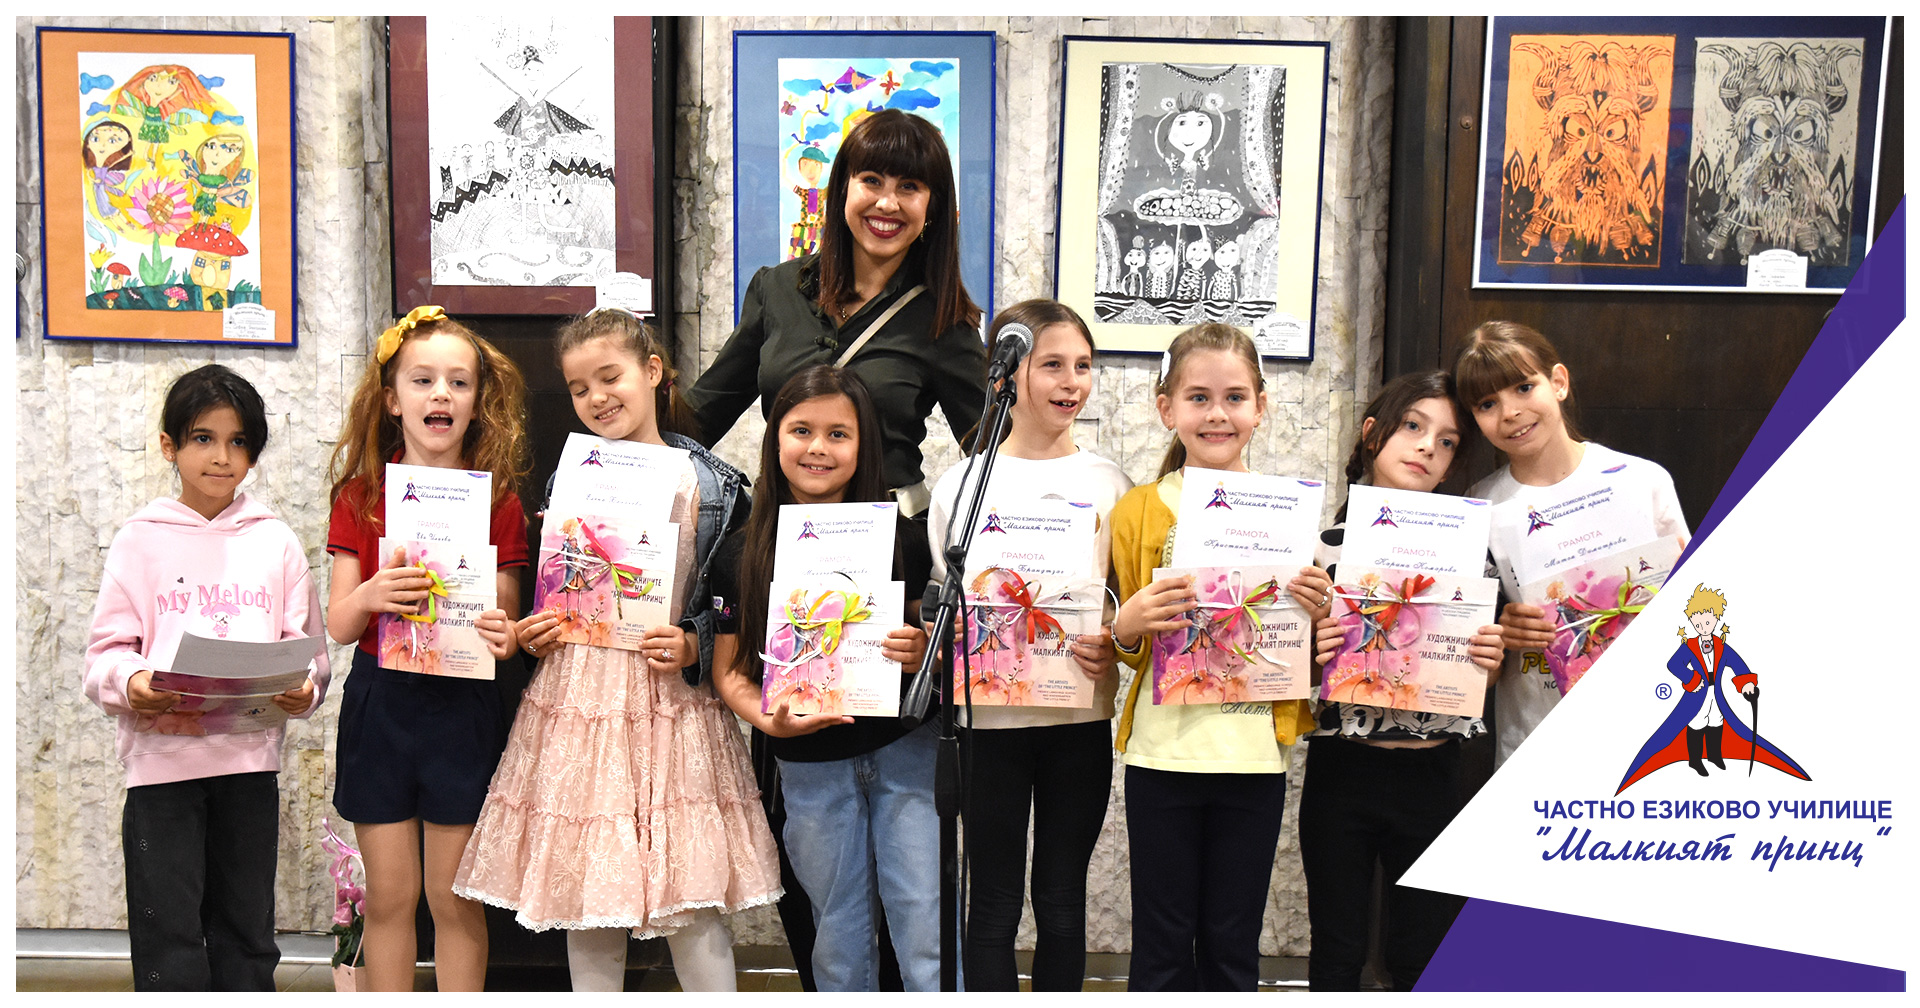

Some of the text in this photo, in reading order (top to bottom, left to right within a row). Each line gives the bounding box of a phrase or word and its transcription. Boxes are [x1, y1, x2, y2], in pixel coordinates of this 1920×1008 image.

[1541, 504, 1562, 514] ЧАСТНО
[1562, 495, 1586, 507] ЕЗИКОВО
[417, 520, 450, 529] ГРАМОТА
[1225, 528, 1269, 539] ГРАМОТА
[1203, 539, 1249, 550] Кристина
[1557, 530, 1603, 550] ГРАМОТА
[1001, 551, 1045, 561] ГРАМОТА
[1392, 546, 1437, 558] ГРАМОТА
[817, 555, 852, 563] РАМОТА
[1374, 557, 1457, 573] Карина Комарова
[157, 583, 273, 615] My Melody
[442, 601, 484, 612] ХУДОЖНИЦИТЕ
[1248, 622, 1298, 634] ХДОЖНИЦИТЕ
[1268, 632, 1277, 640] НА
[1426, 633, 1475, 646] ХУДОЖНИЦИ
[847, 639, 883, 648] ХУДОЖНИЦ
[1242, 640, 1277, 650] "МЛКИЯТ
[1446, 645, 1456, 653] НА
[1455, 655, 1478, 666] ПРИН
